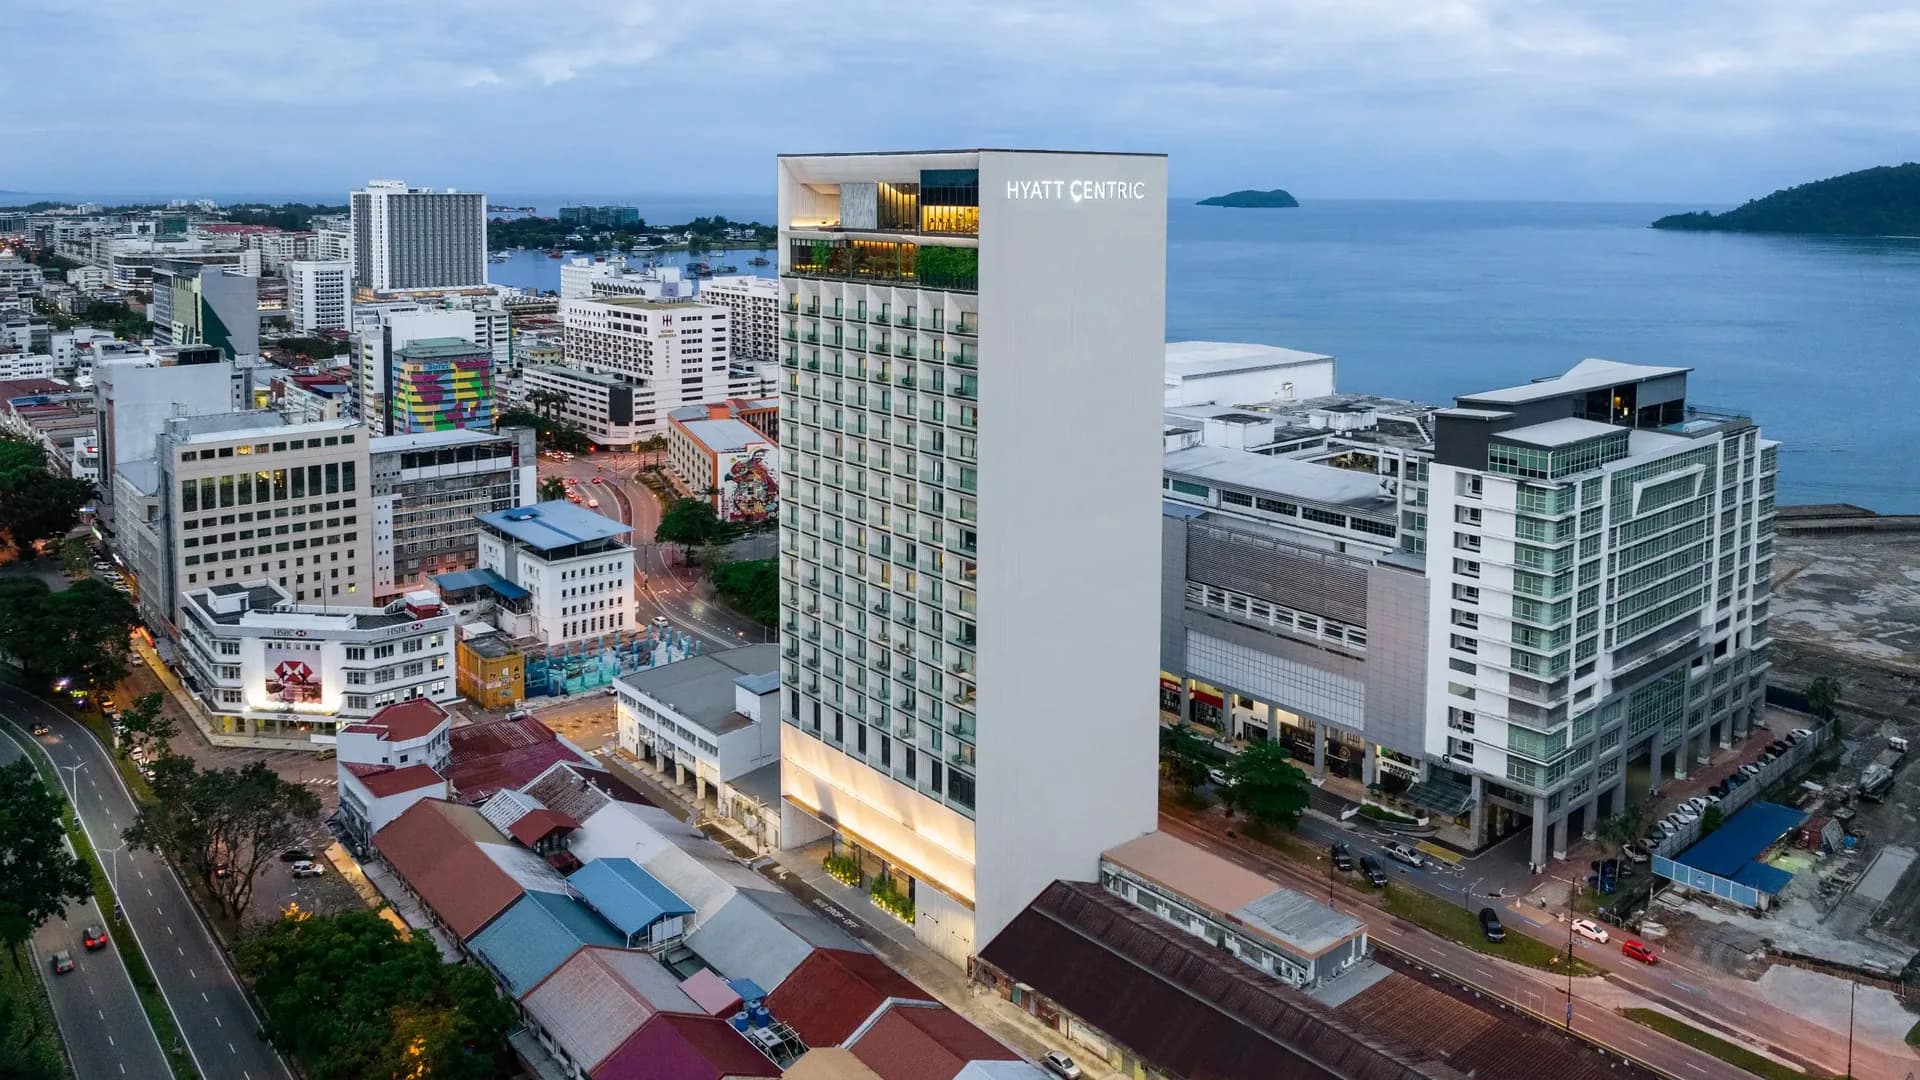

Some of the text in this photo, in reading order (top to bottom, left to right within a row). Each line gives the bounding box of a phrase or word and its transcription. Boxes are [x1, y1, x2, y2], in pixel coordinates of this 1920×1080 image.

[1007, 180, 1145, 202] HYATT CENTRIC
[273, 628, 295, 637] HSBC
